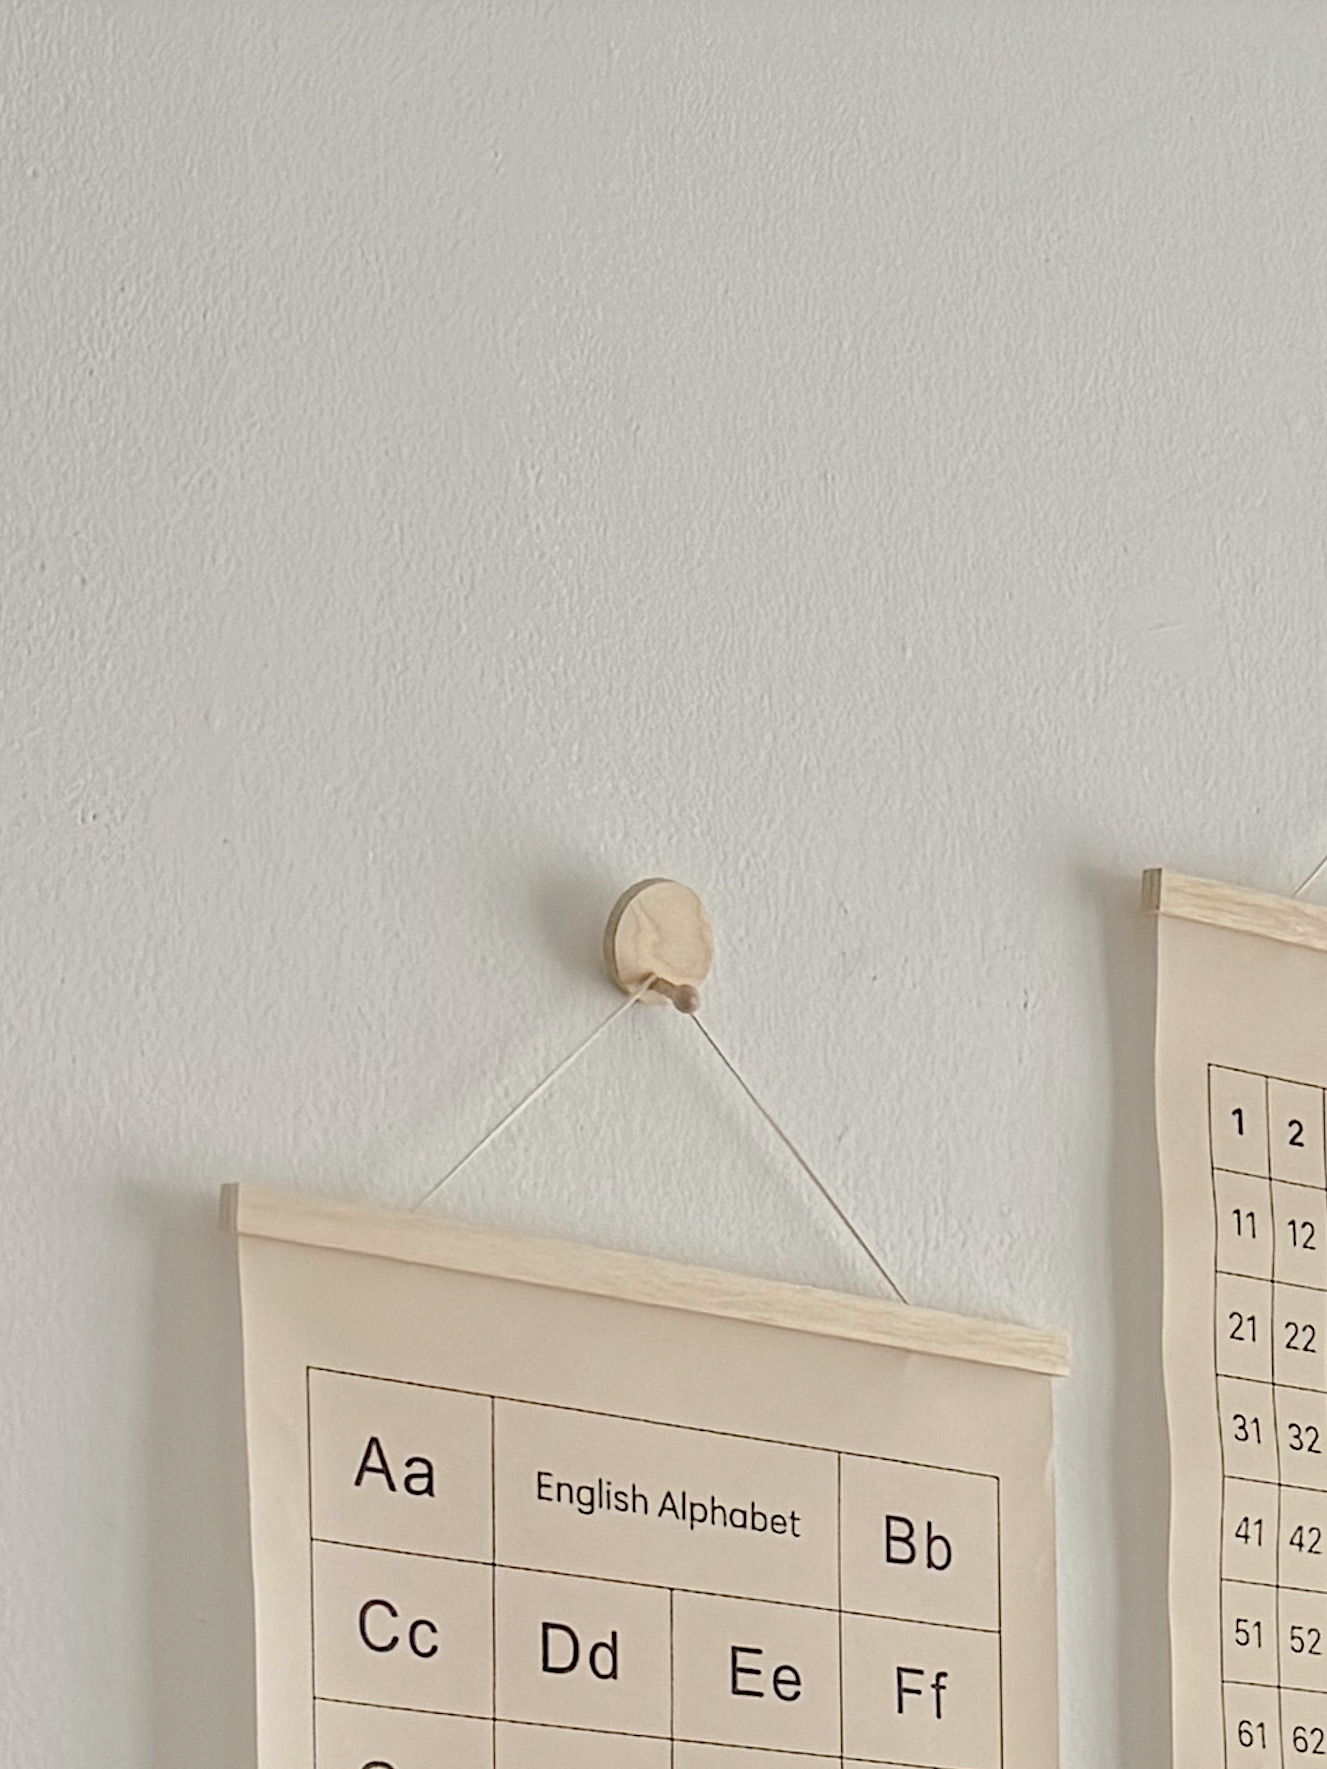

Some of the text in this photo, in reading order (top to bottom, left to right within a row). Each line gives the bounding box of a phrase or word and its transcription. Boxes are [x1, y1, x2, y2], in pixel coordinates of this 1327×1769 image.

[1231, 1107, 1244, 1137] 1
[1287, 1118, 1305, 1148] 2
[1231, 1208, 1257, 1240] 11
[1287, 1218, 1317, 1251] 12
[1232, 1413, 1262, 1445] 31
[1287, 1422, 1323, 1455] 32
[353, 1435, 953, 1572] Aa English Alphabet Bb
[1234, 1617, 1262, 1649] 51
[1290, 1624, 1323, 1656] 52
[358, 1598, 949, 1720] Cc Dd Ee Ff
